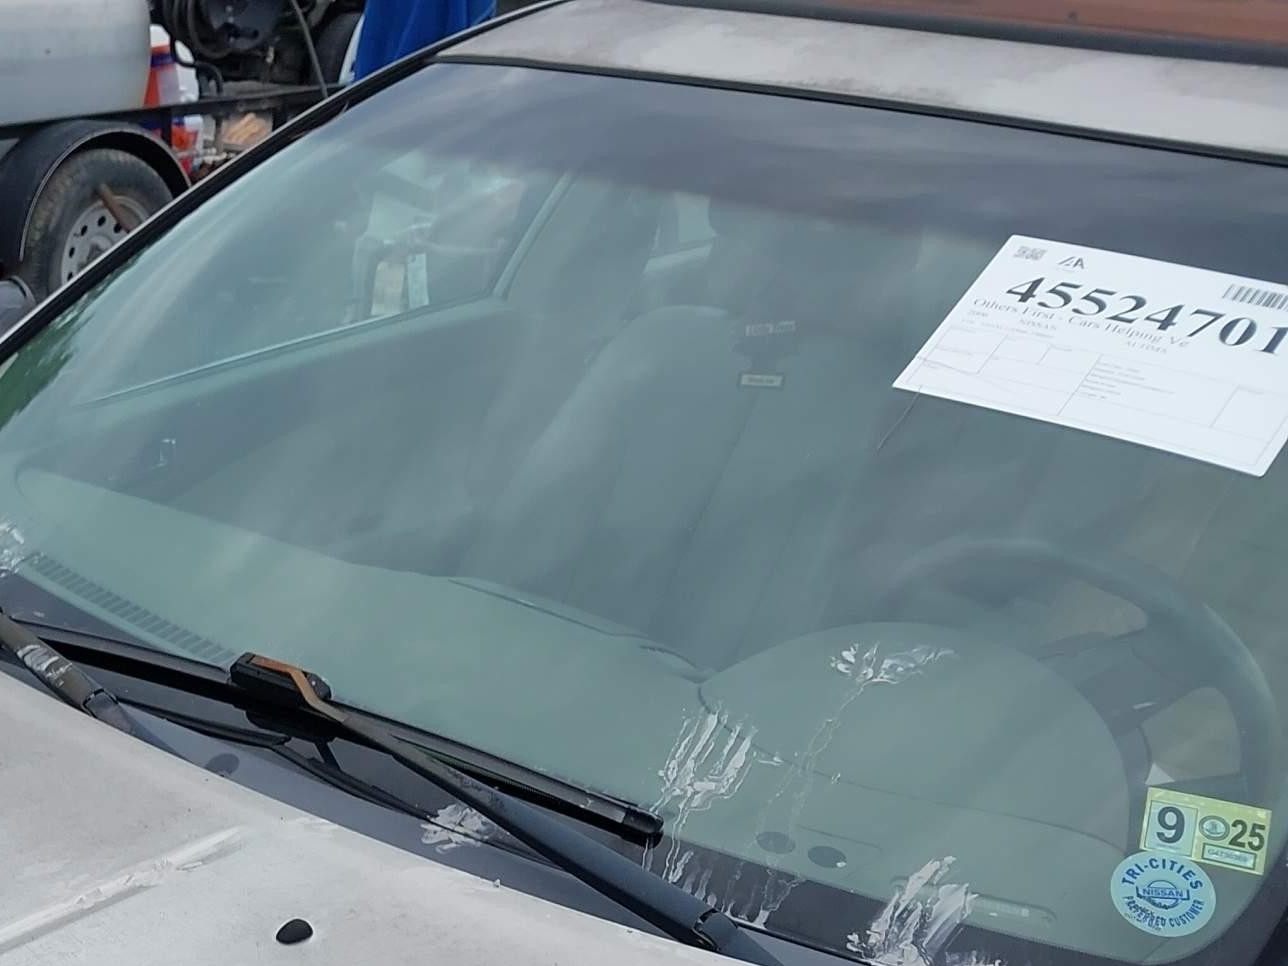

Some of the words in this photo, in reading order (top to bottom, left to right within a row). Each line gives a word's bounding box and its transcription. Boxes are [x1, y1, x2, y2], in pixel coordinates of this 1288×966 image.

[973, 298, 1018, 314] Others
[1022, 306, 1057, 321] First
[1068, 316, 1100, 329] Cars
[1105, 322, 1163, 344] Helping
[1006, 276, 1288, 355] 45524701
[1156, 806, 1185, 844] 9
[1229, 819, 1266, 851] 25
[1121, 857, 1203, 889] TRI-CITIES
[1142, 887, 1184, 897] NISSAN
[1168, 899, 1205, 927] CUSTOMER
